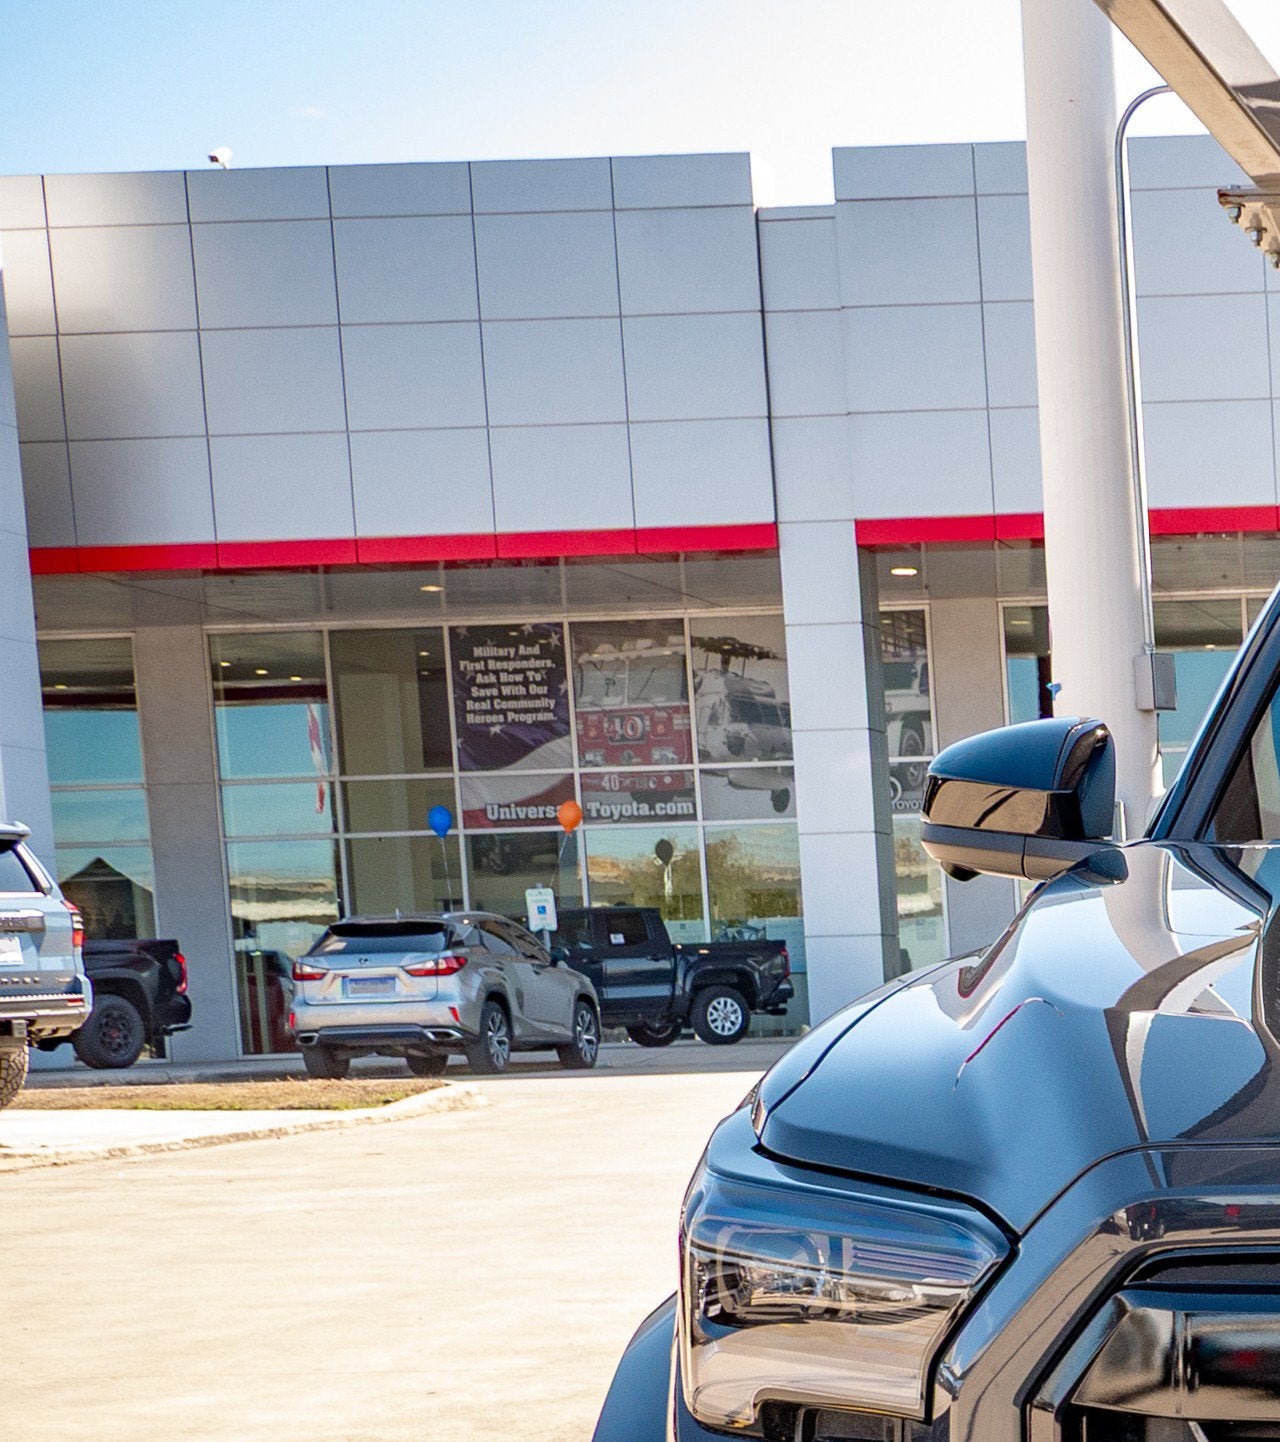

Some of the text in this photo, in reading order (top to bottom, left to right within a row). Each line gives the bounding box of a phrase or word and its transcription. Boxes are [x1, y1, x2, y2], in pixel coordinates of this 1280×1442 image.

[473, 644, 541, 658] Military And
[460, 658, 556, 671] First Responders,
[476, 670, 542, 684] Ask How To
[471, 683, 549, 697] Save With Our
[466, 697, 556, 711] Real Community
[466, 711, 558, 724] Heroes Program.
[602, 774, 620, 791] 40
